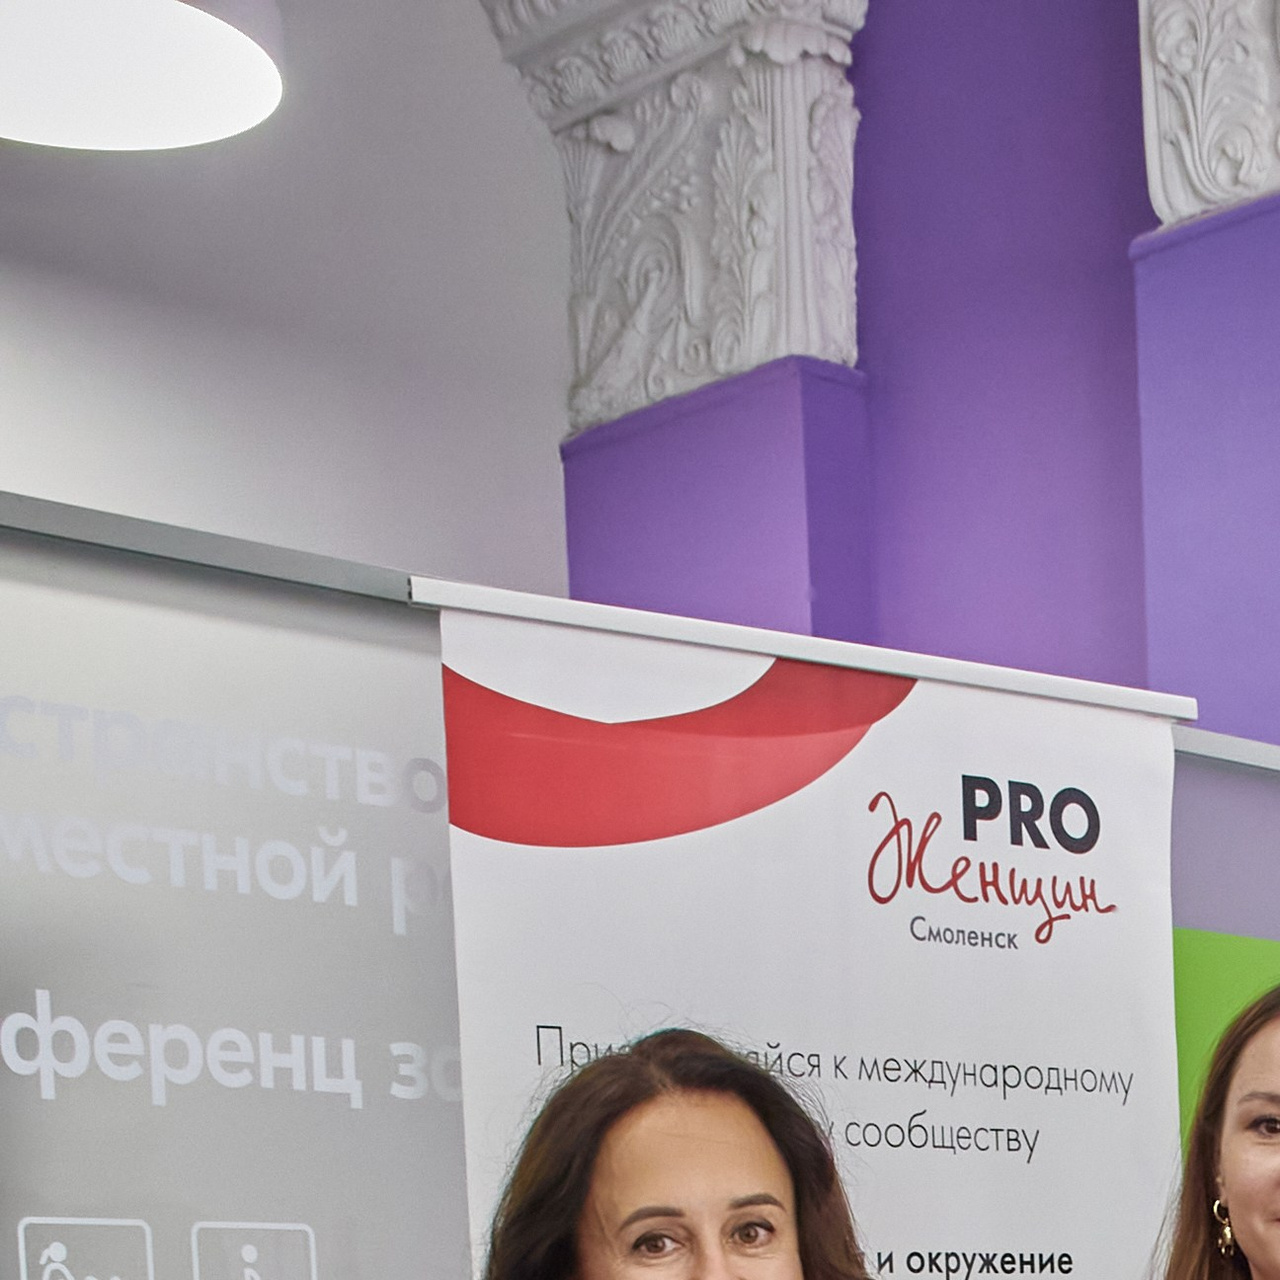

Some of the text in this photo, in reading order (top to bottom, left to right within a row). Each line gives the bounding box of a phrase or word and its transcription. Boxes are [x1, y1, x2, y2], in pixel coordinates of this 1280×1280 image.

[961, 773, 1101, 855] PRO
[867, 791, 1117, 944] Женщин
[909, 916, 1019, 950] Смоленск
[0, 987, 365, 1111] ференц
[833, 1054, 849, 1080] к
[858, 1056, 1134, 1106] международному
[844, 1109, 1040, 1165] сообществу
[876, 1250, 894, 1274] и
